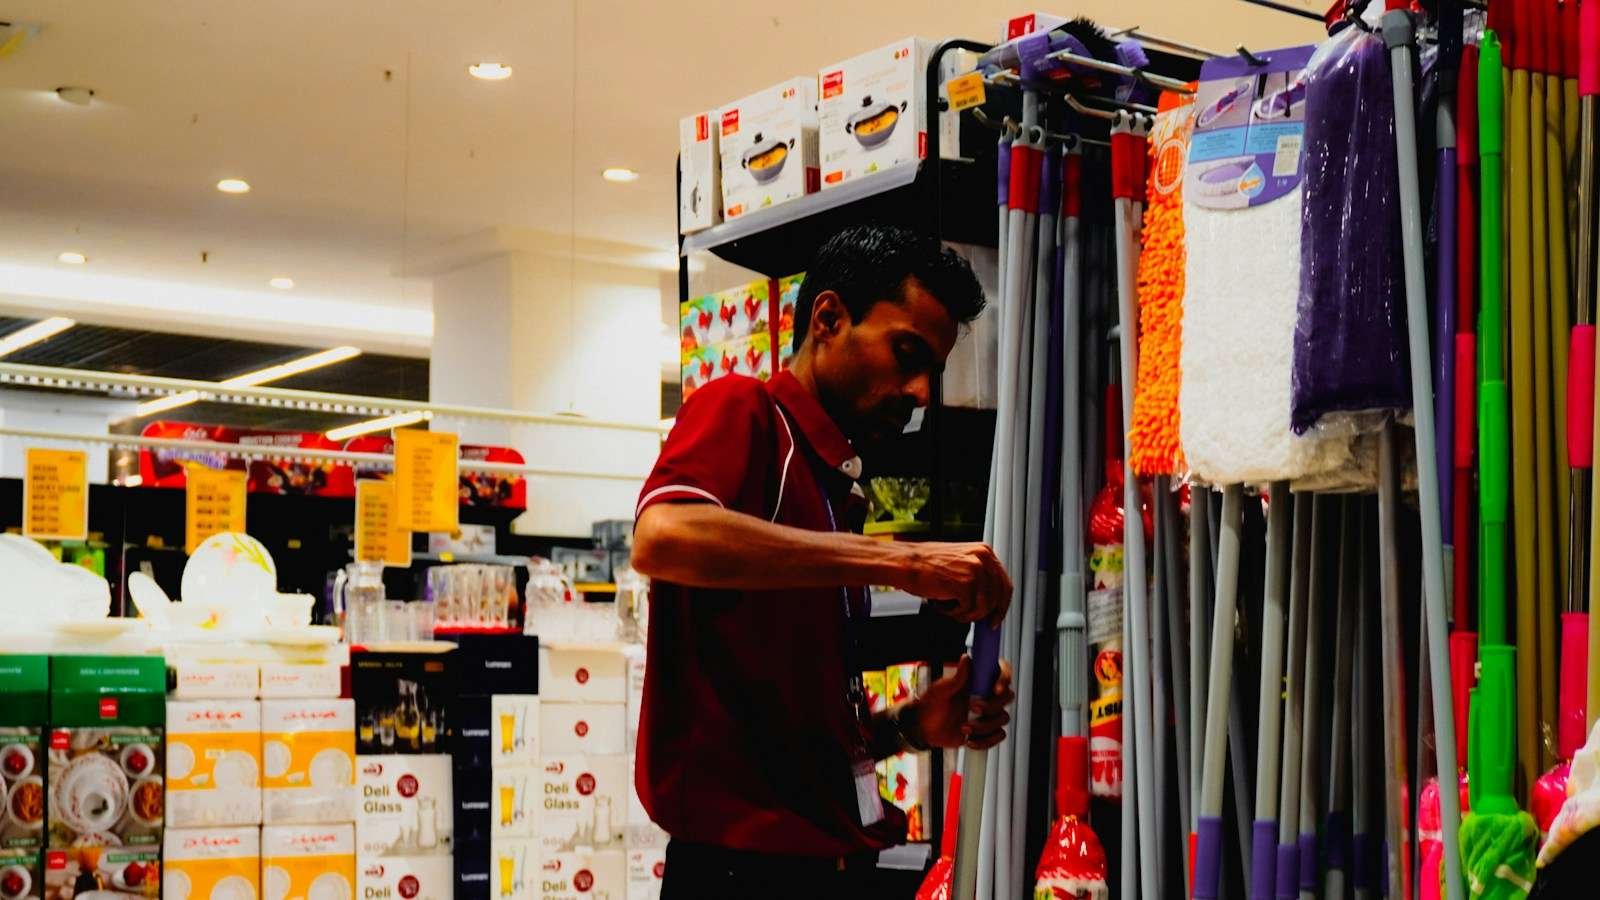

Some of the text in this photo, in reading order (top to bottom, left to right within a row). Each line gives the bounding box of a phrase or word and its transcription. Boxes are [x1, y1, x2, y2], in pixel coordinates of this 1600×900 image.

[363, 784, 390, 797] Deli
[544, 782, 569, 794] Deli
[363, 801, 402, 813] Glass
[544, 798, 580, 810] Glass
[364, 886, 391, 898] Deli
[542, 880, 567, 892] Deli
